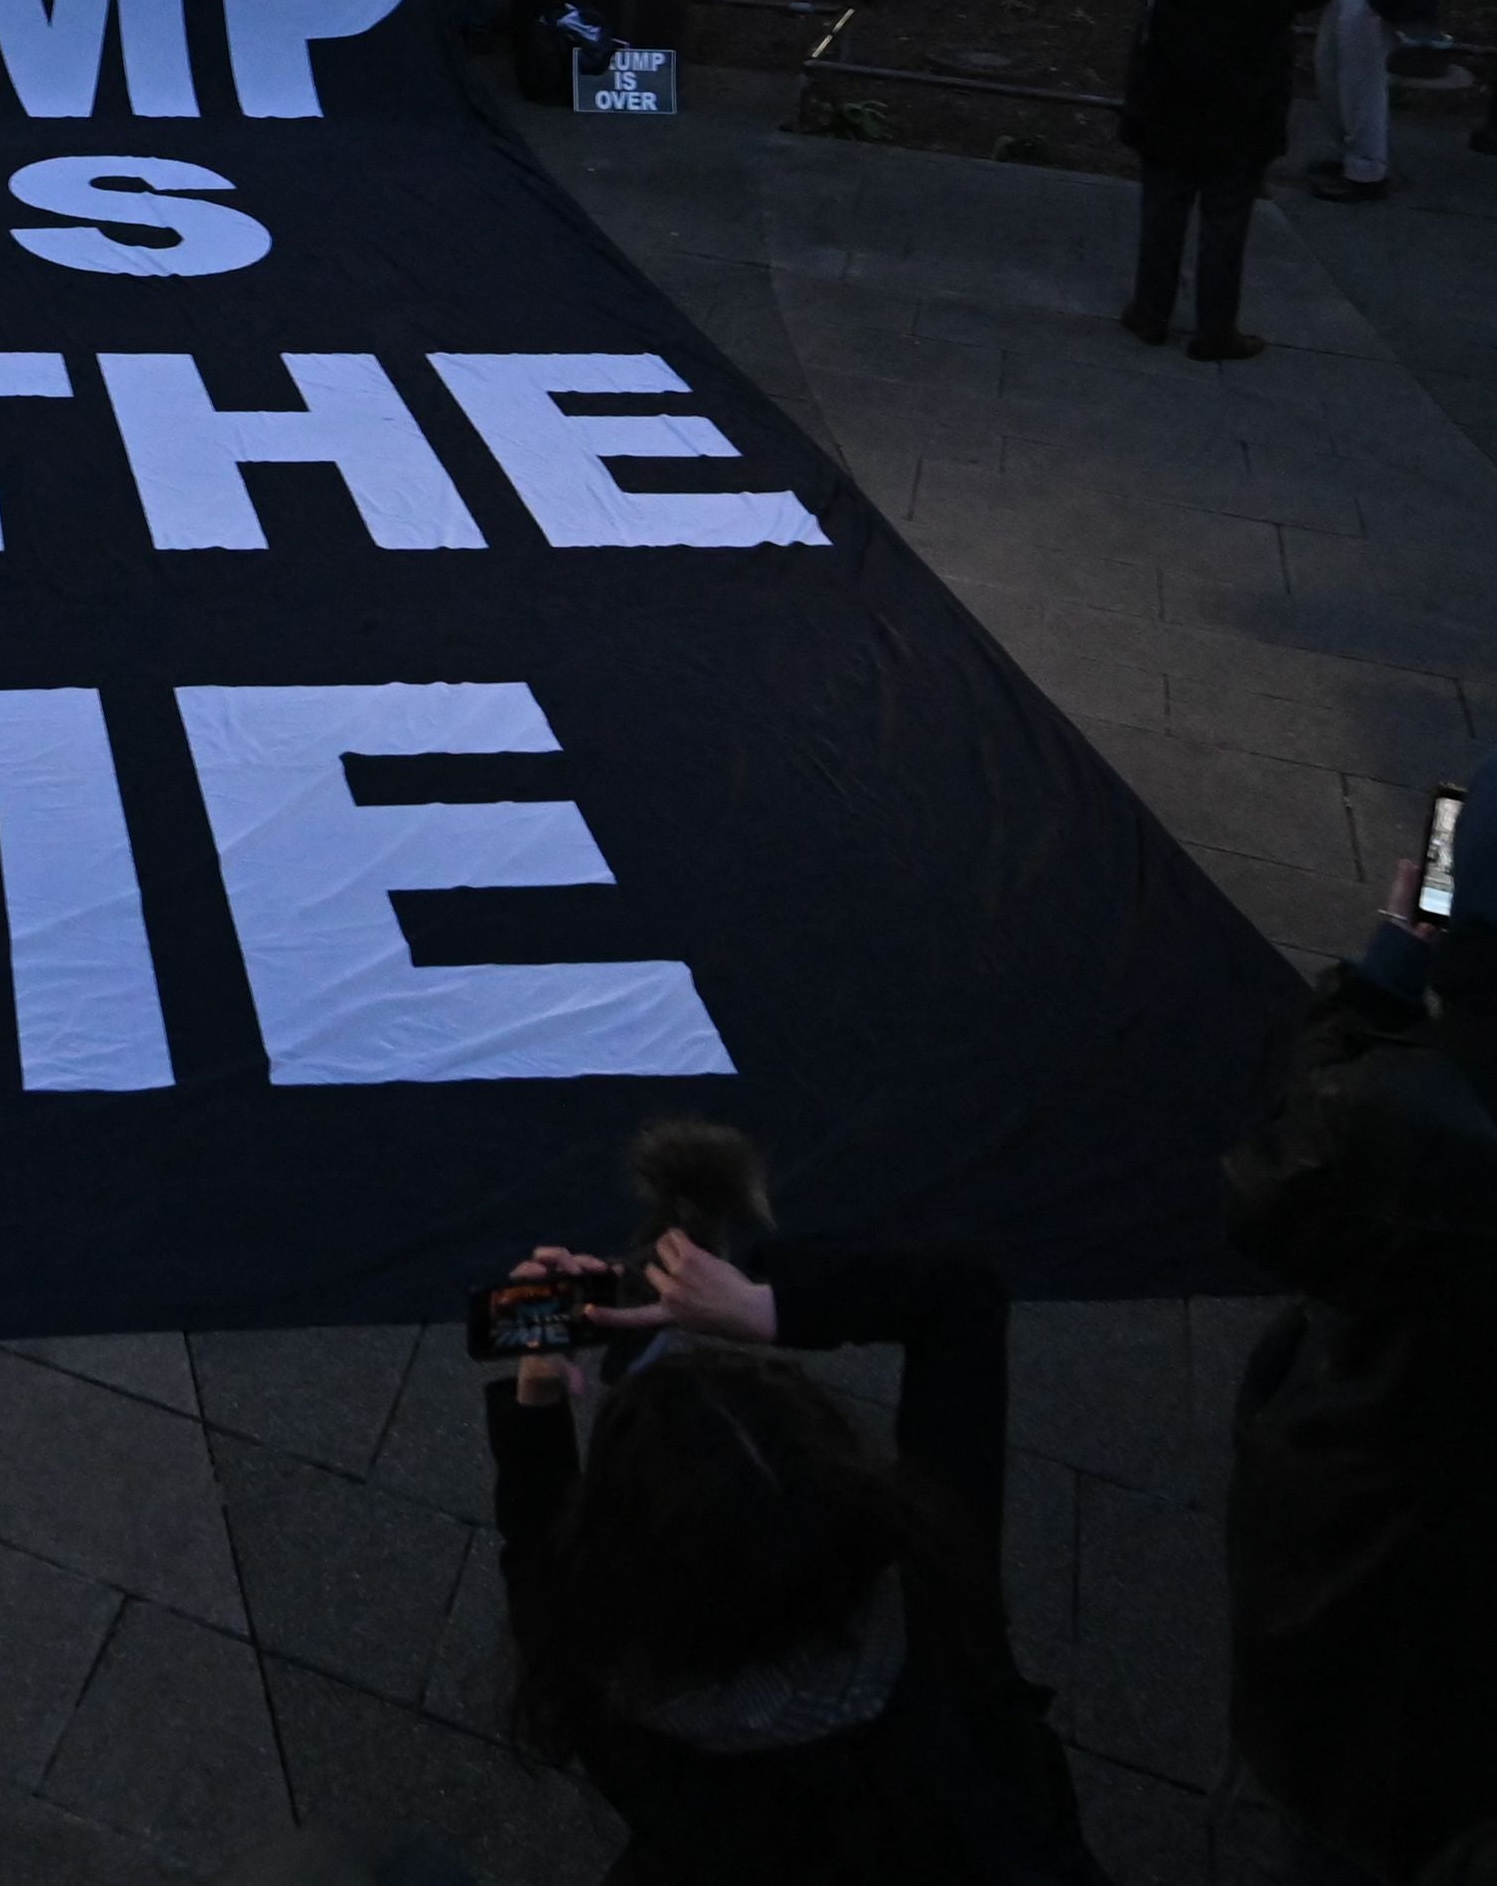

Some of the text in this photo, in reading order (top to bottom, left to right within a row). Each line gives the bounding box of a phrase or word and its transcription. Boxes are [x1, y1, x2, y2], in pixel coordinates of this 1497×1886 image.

[608, 50, 666, 71] UMP
[614, 71, 638, 91] IS
[594, 90, 658, 111] OVER
